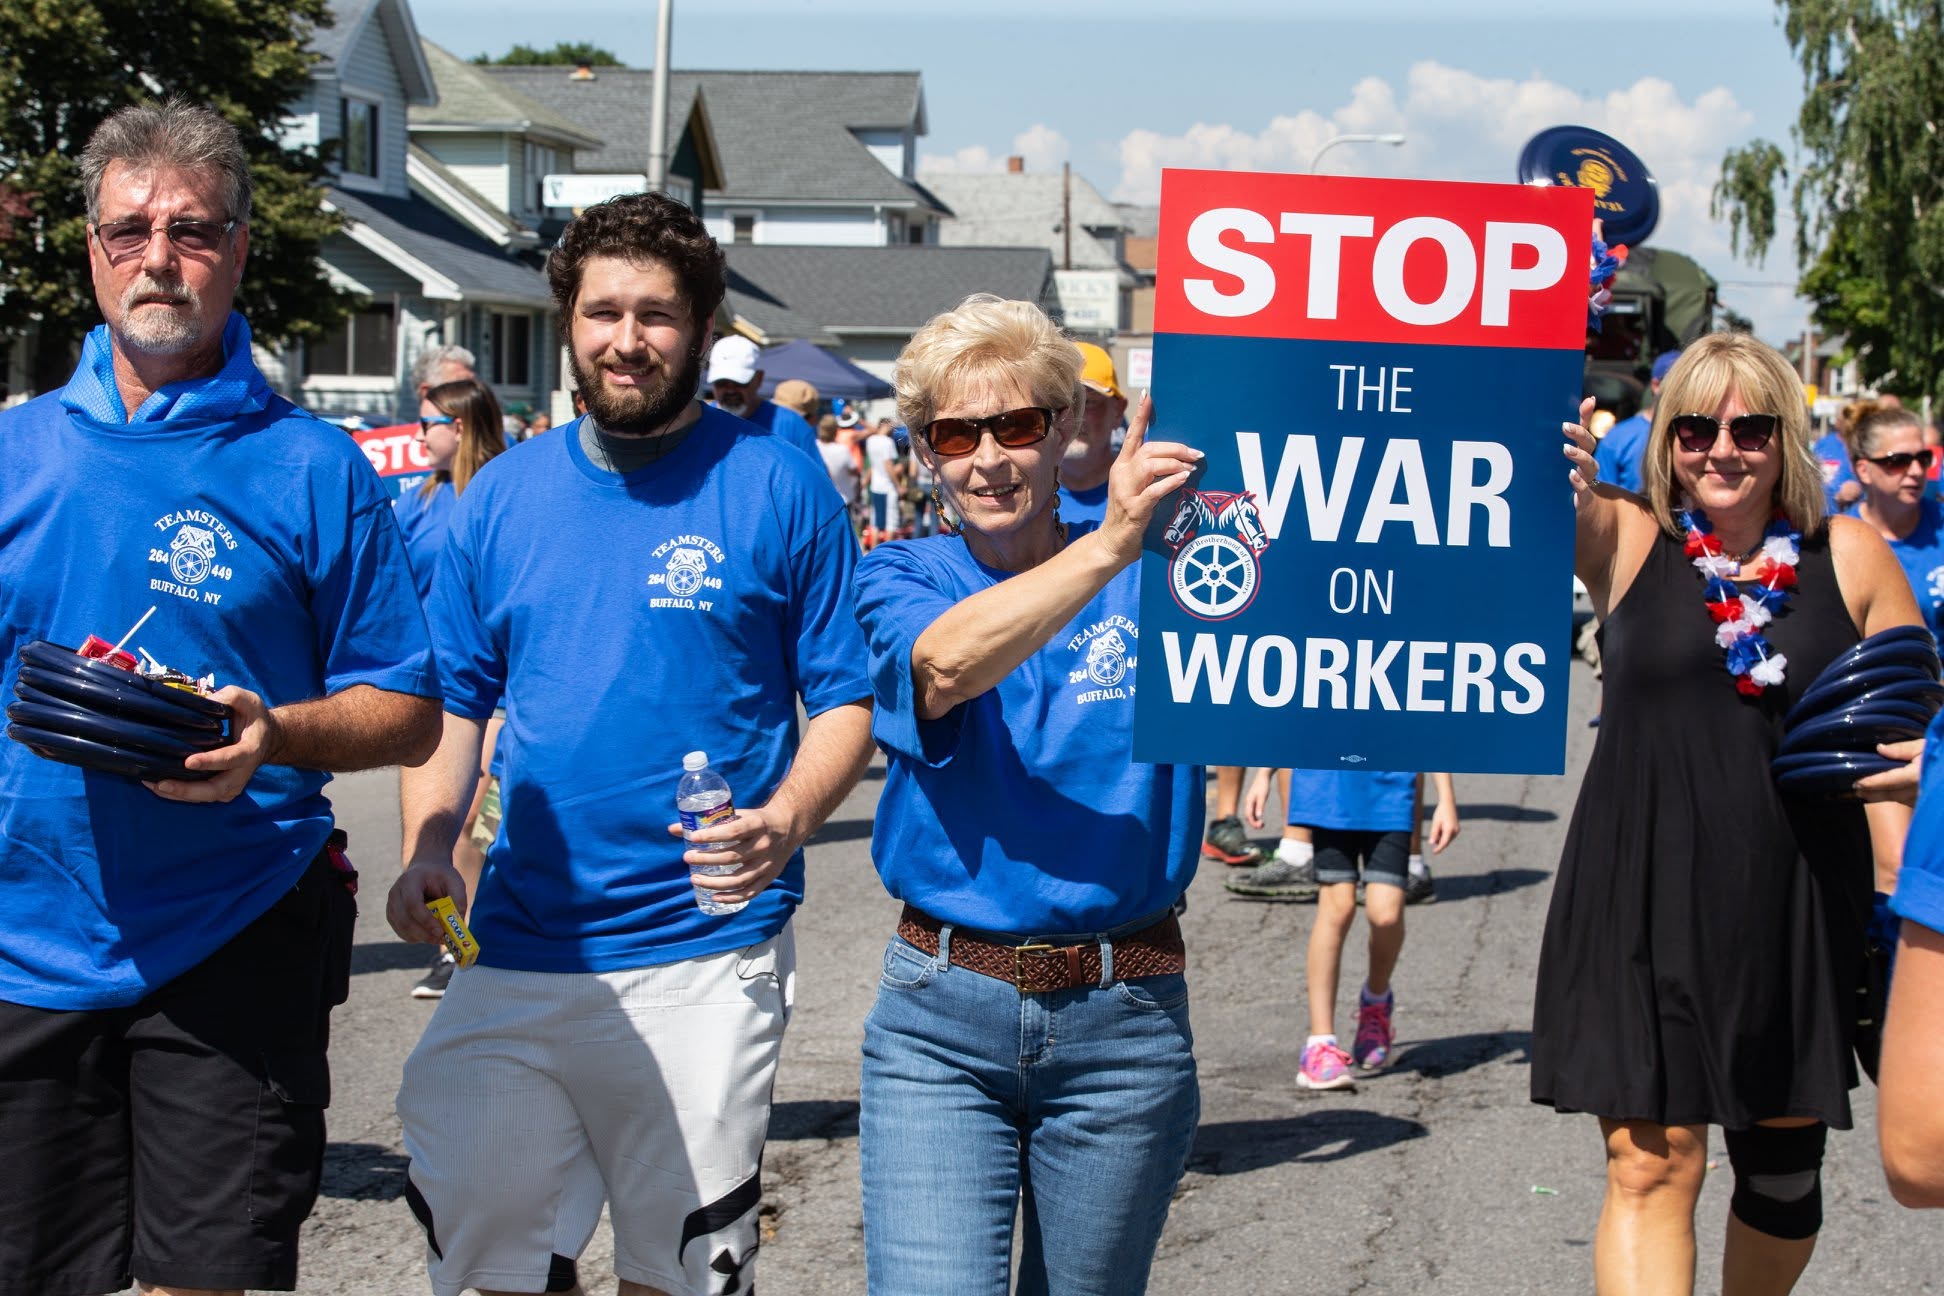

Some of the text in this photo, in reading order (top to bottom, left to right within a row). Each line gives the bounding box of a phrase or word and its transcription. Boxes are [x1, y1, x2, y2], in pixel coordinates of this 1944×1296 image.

[1184, 207, 1568, 327] STOP
[1329, 364, 1414, 413] THE
[1236, 431, 1514, 548] WAR
[154, 509, 238, 551] TEAMSTERS
[651, 534, 726, 564] TEAMSTERS
[1195, 535, 1241, 552] Brotherhood
[148, 548, 170, 564] 264
[211, 564, 233, 581] 449
[648, 574, 665, 584] 264
[704, 577, 721, 589] 449
[150, 578, 222, 605] BUFFALO, NY
[1329, 567, 1395, 615] ON
[650, 599, 713, 611] BUFFALO, NY
[1069, 669, 1088, 684] 264
[1161, 631, 1546, 715] WORKERS
[1076, 687, 1127, 705] BUFFALO,
